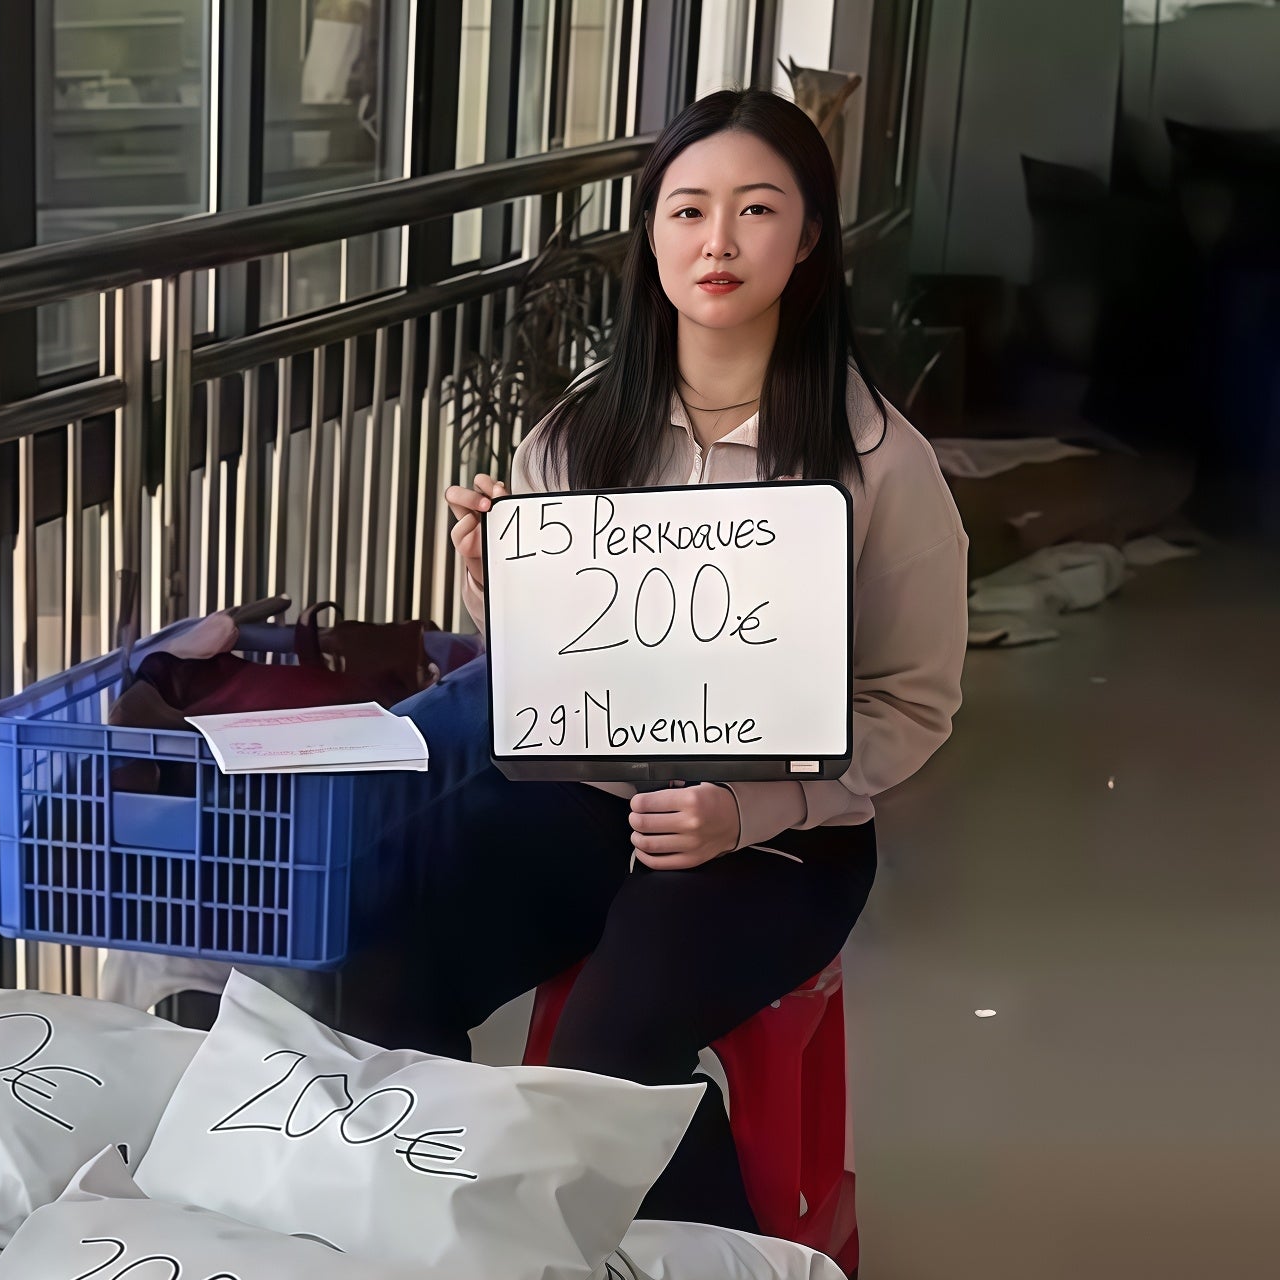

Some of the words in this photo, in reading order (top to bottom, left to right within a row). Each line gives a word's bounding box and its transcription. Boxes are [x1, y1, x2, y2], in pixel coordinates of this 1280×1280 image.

[499, 501, 573, 561] 15
[558, 563, 778, 655] 200€
[210, 1050, 478, 1181] 200€
